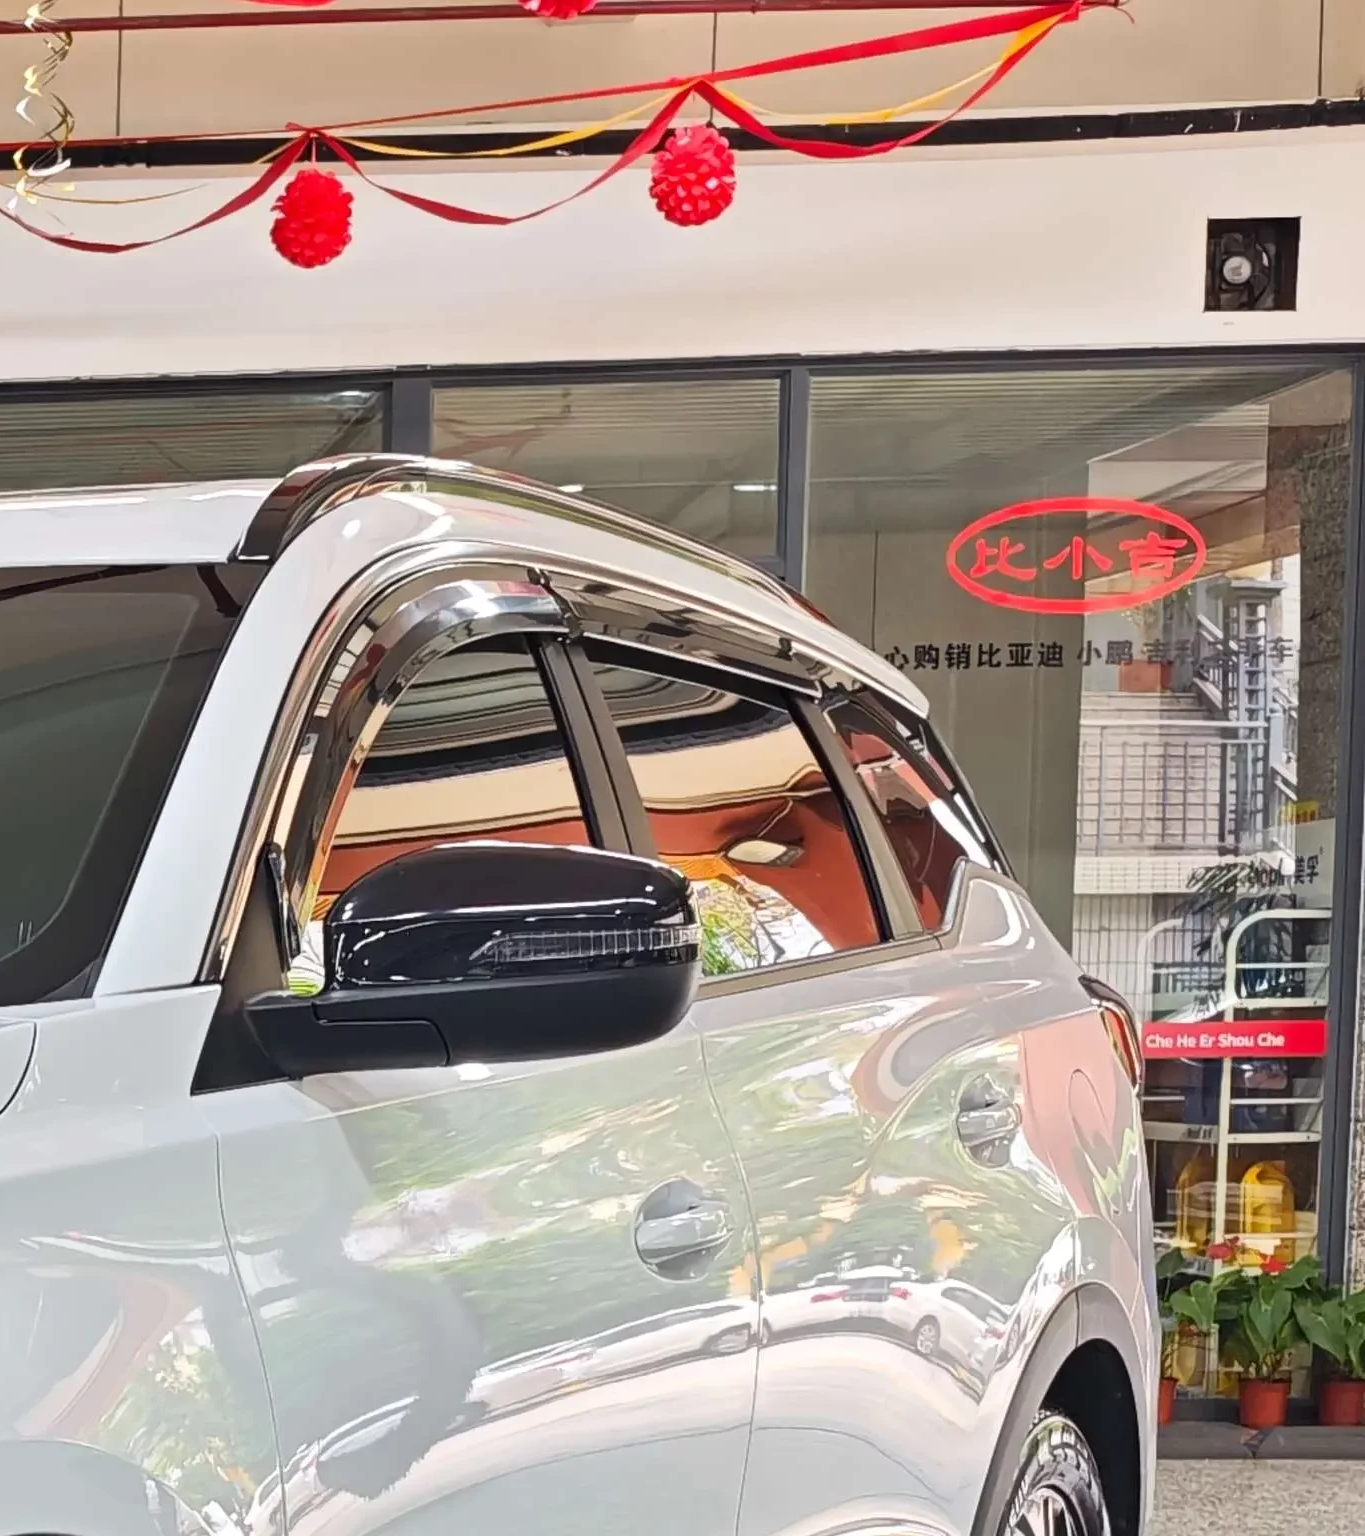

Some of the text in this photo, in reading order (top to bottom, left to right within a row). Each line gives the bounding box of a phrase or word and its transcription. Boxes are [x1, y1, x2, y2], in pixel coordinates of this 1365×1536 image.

[970, 531, 1188, 580] 比小吉
[885, 641, 1064, 670] 心购销比亚迪
[1145, 1031, 1285, 1048] Che He Er Shou Che
